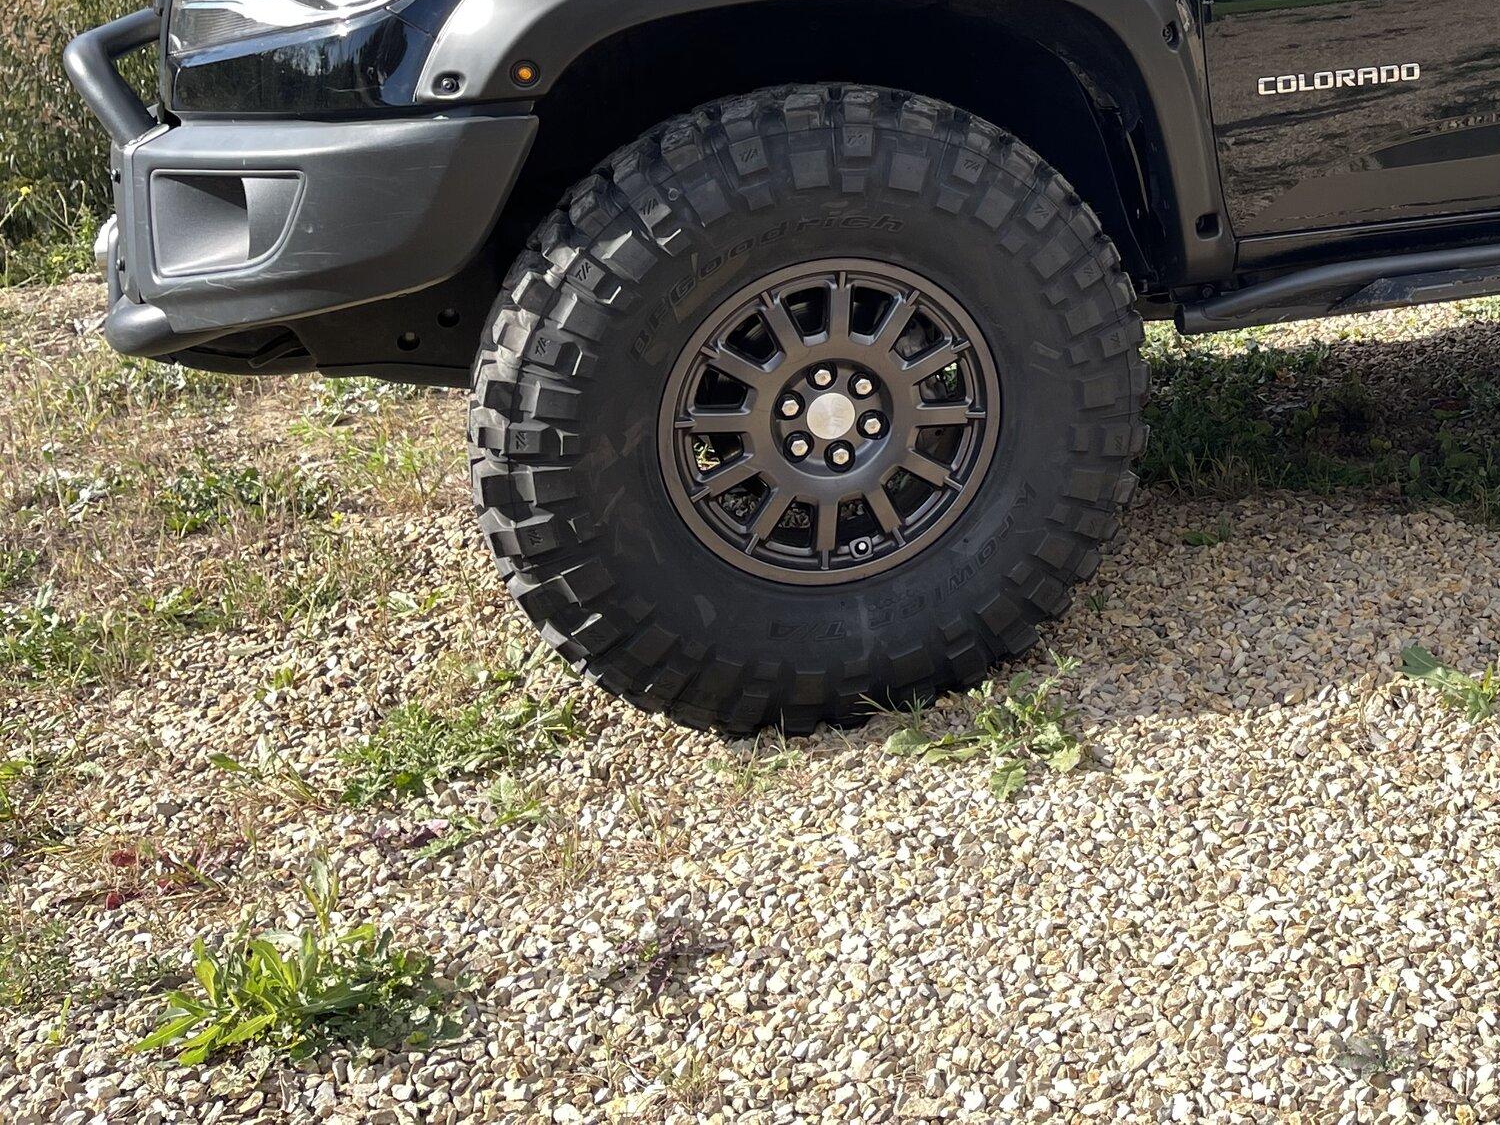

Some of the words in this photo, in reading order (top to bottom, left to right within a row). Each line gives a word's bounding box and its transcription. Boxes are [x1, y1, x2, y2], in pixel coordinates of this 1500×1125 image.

[1257, 62, 1421, 96] COLORADO
[575, 261, 593, 281] T/A
[535, 336, 551, 356] T/A
